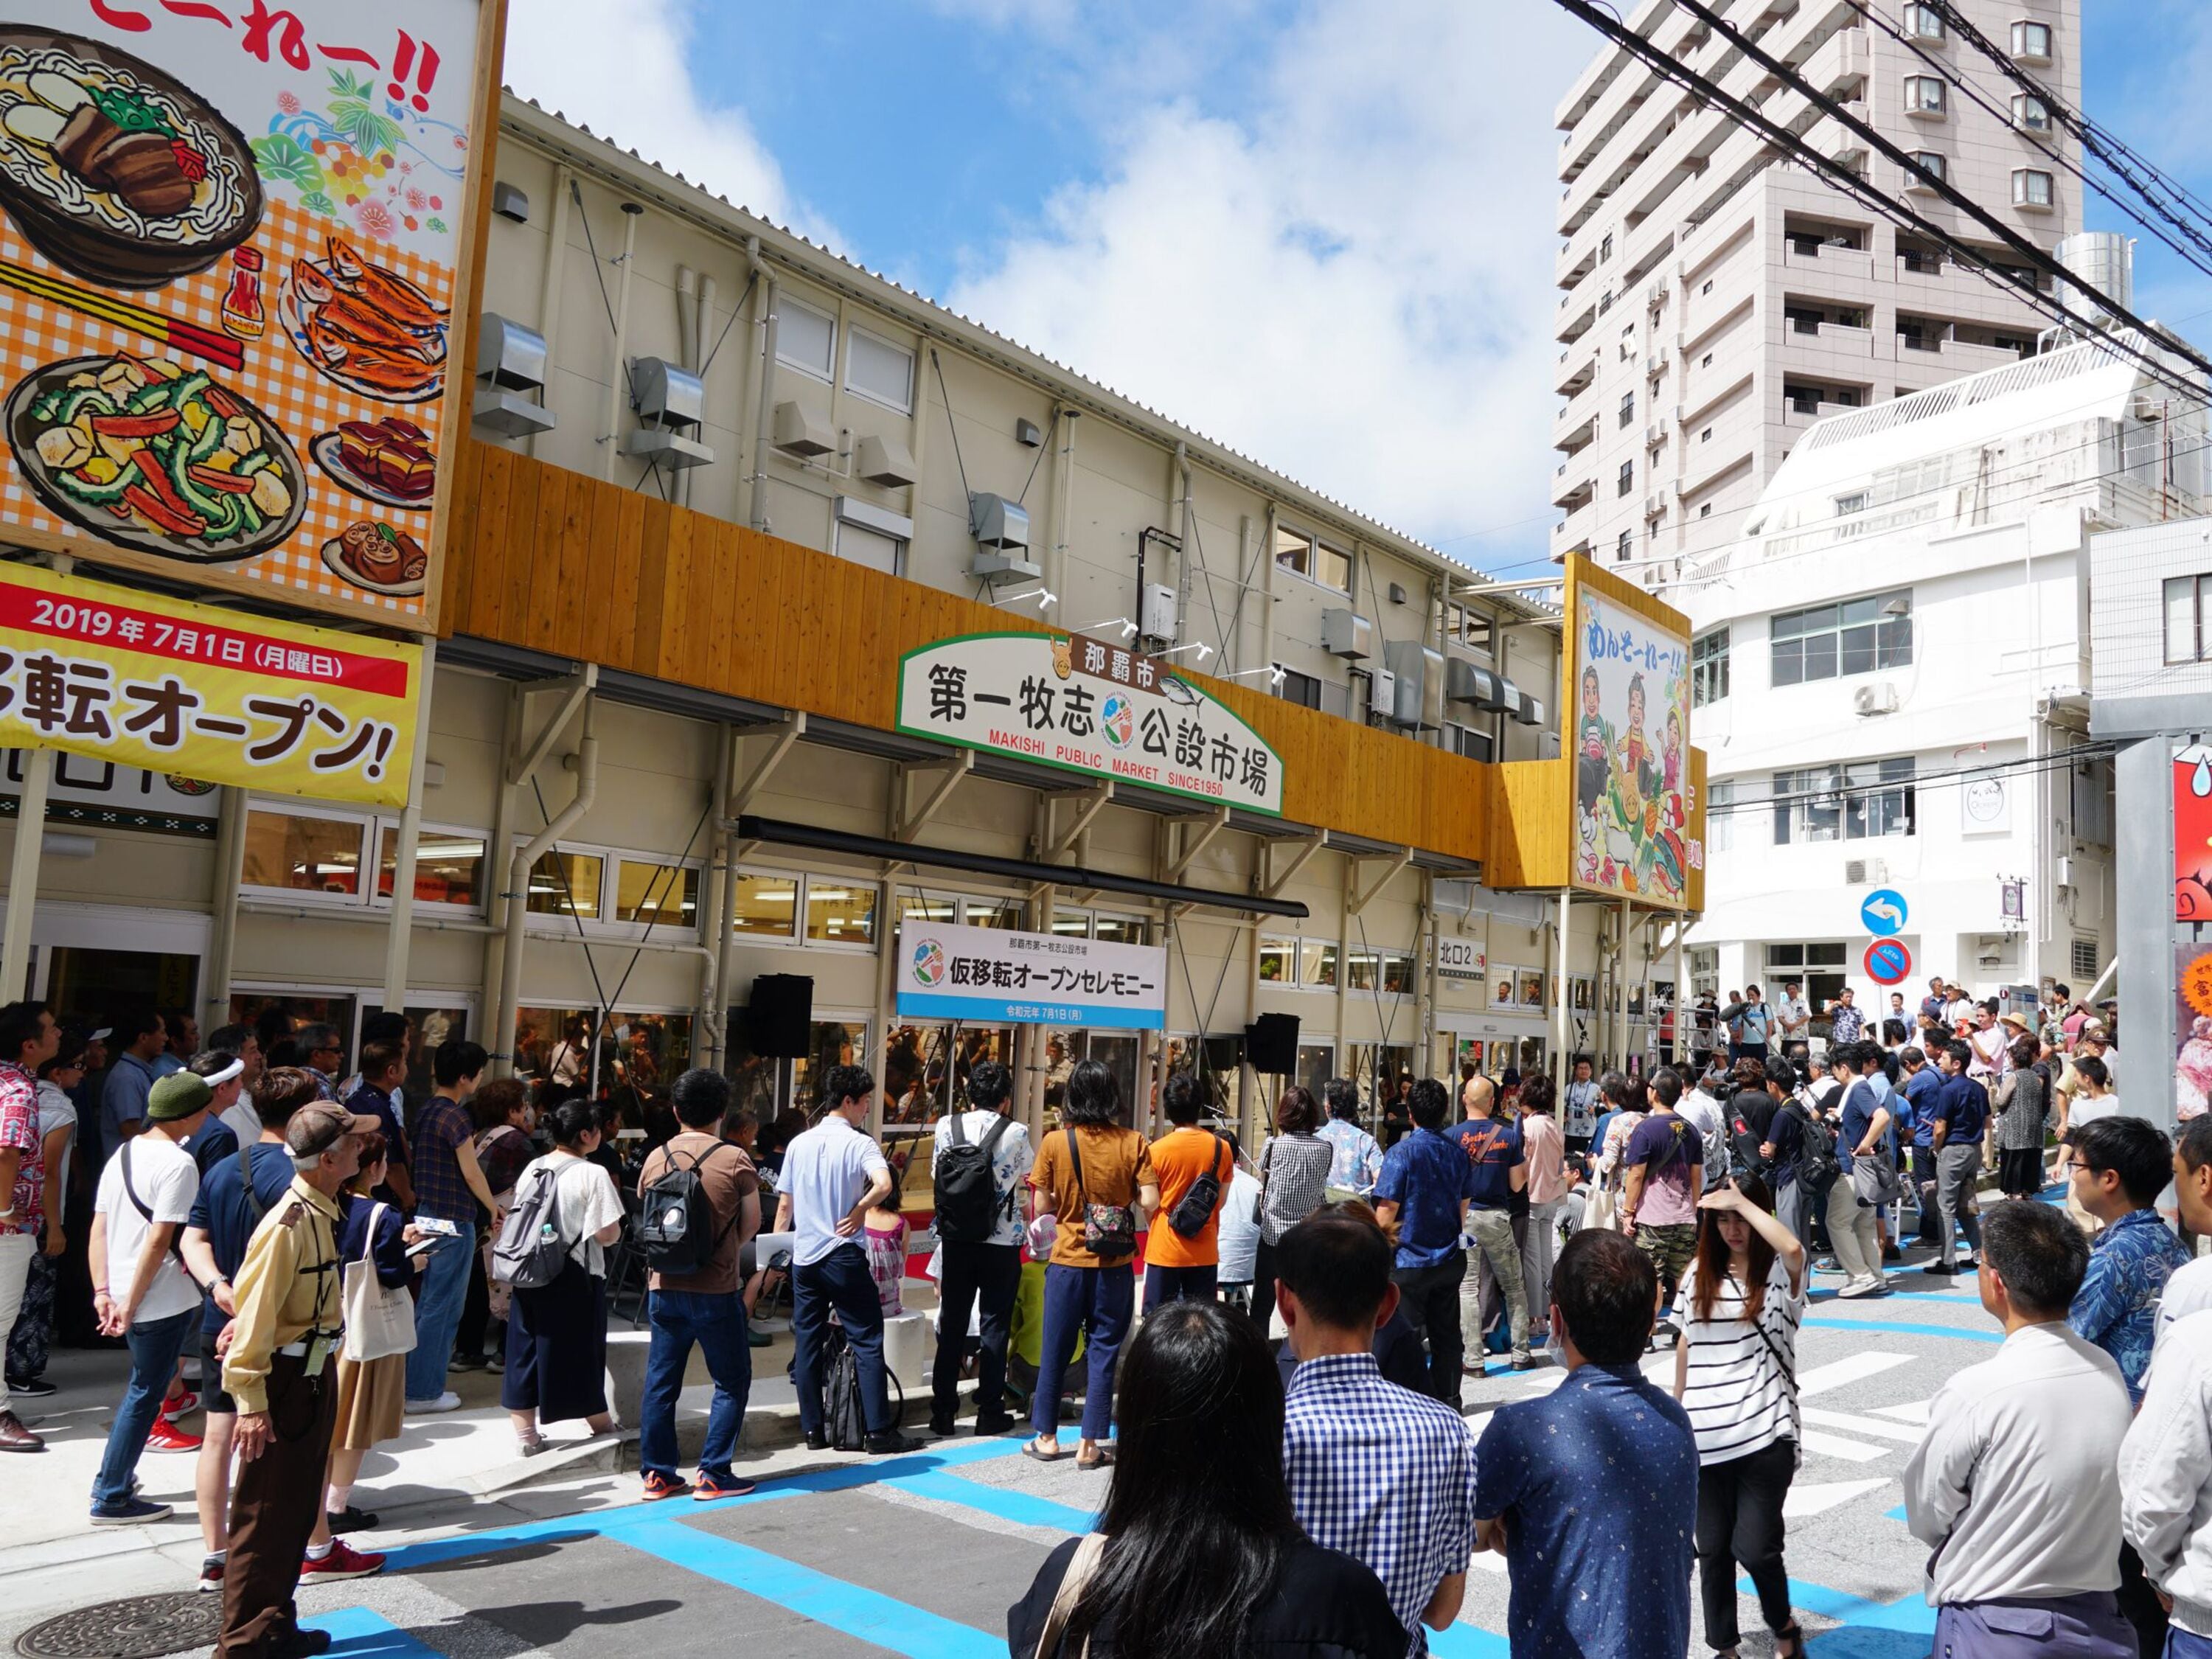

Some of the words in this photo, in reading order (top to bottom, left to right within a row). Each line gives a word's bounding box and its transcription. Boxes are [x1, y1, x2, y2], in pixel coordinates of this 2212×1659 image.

[1084, 640, 1155, 689] 那覇市
[1587, 618, 1681, 677] めんそーれー!!
[928, 663, 1096, 737] 第一牧志
[1140, 707, 1268, 797] 公設市場
[989, 728, 1046, 755] MAKISHI
[1056, 745, 1103, 768] PUBLIC
[1112, 759, 1158, 782] MARKET
[1167, 772, 1223, 796] SINCE1950
[1009, 937, 1088, 956] 那覇市第一牧志公設市場
[1440, 942, 1472, 965] 北口2
[950, 956, 1155, 996] 仮移転オープンセレモニー
